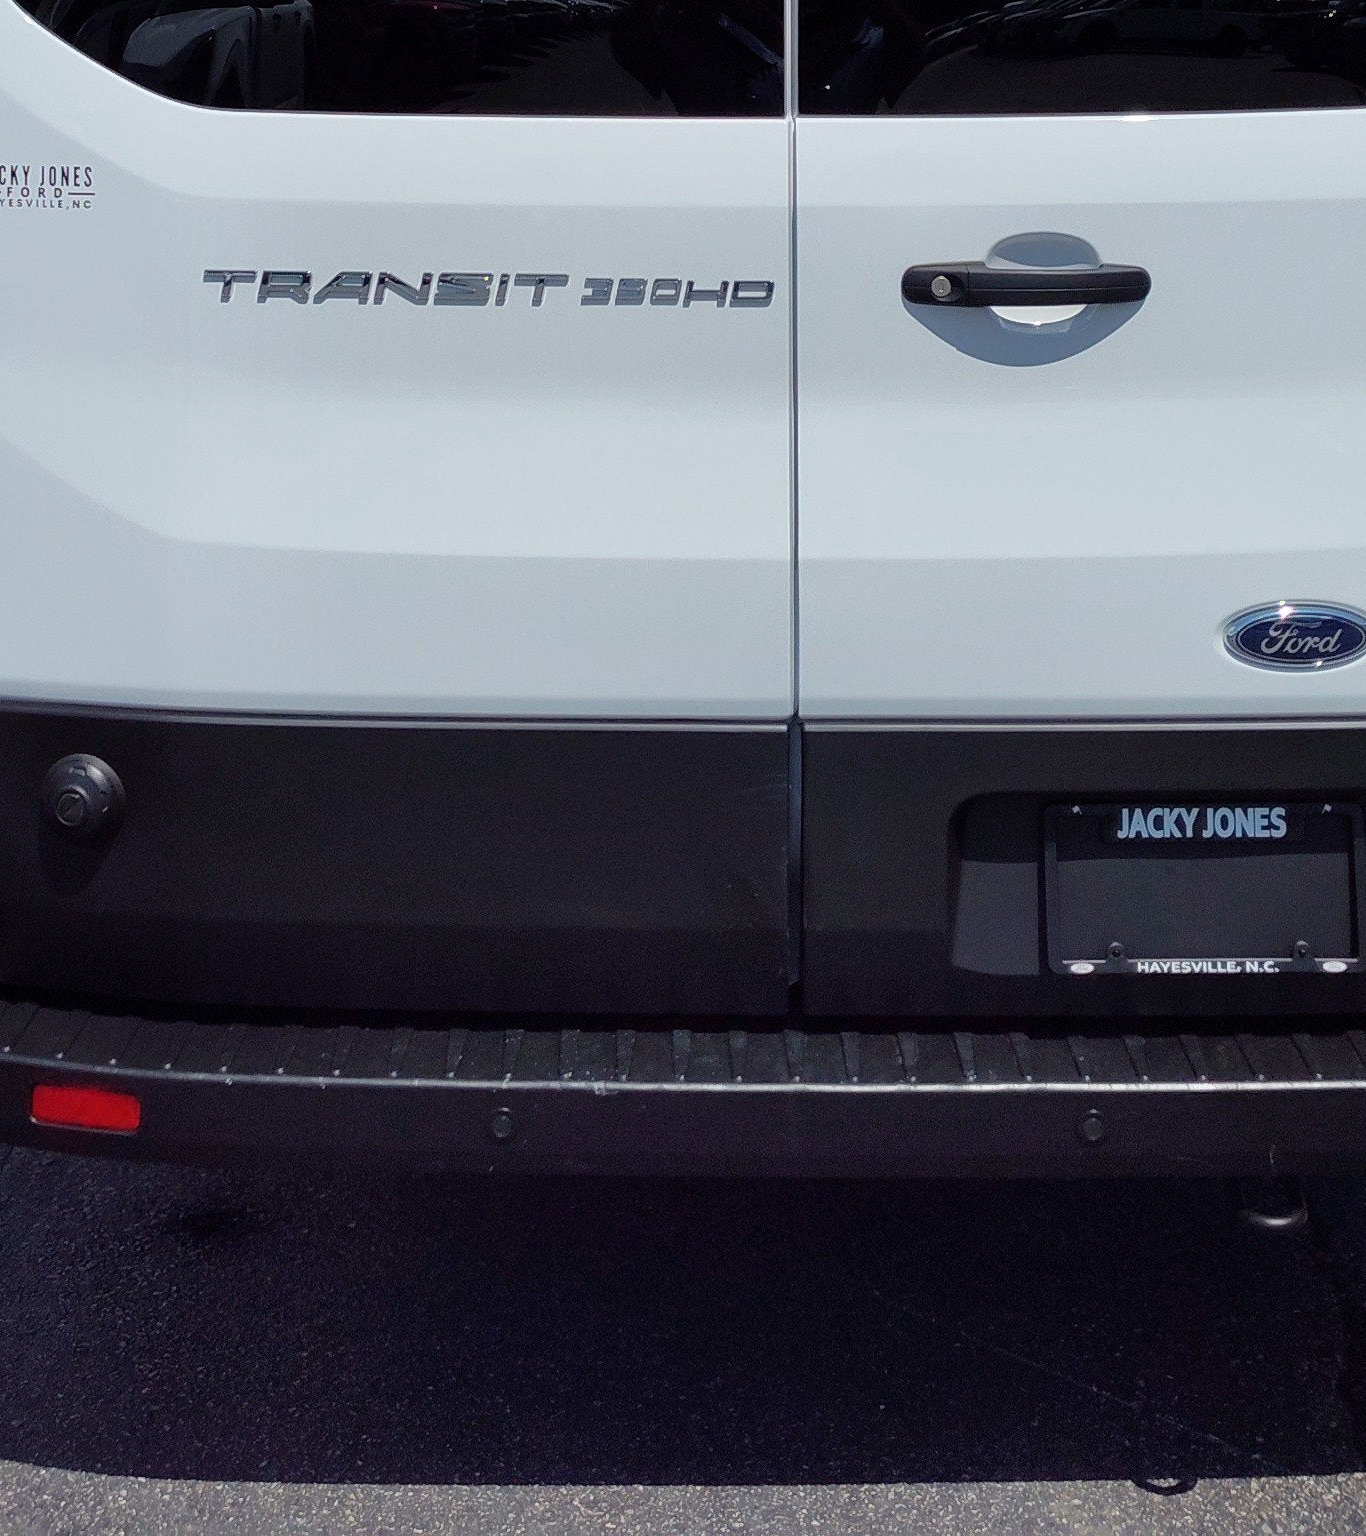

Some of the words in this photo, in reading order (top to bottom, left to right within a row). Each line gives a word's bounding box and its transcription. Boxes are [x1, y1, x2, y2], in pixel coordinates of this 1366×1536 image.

[40, 165, 92, 187] JONES
[6, 186, 63, 199] FORD
[203, 269, 569, 308] TRANSIT
[1260, 619, 1343, 654] Ford
[1117, 807, 1199, 839] JACKY
[1202, 806, 1287, 839] JONES
[1137, 961, 1241, 974] HAYESVILLE,
[1246, 961, 1280, 974] N.C.
